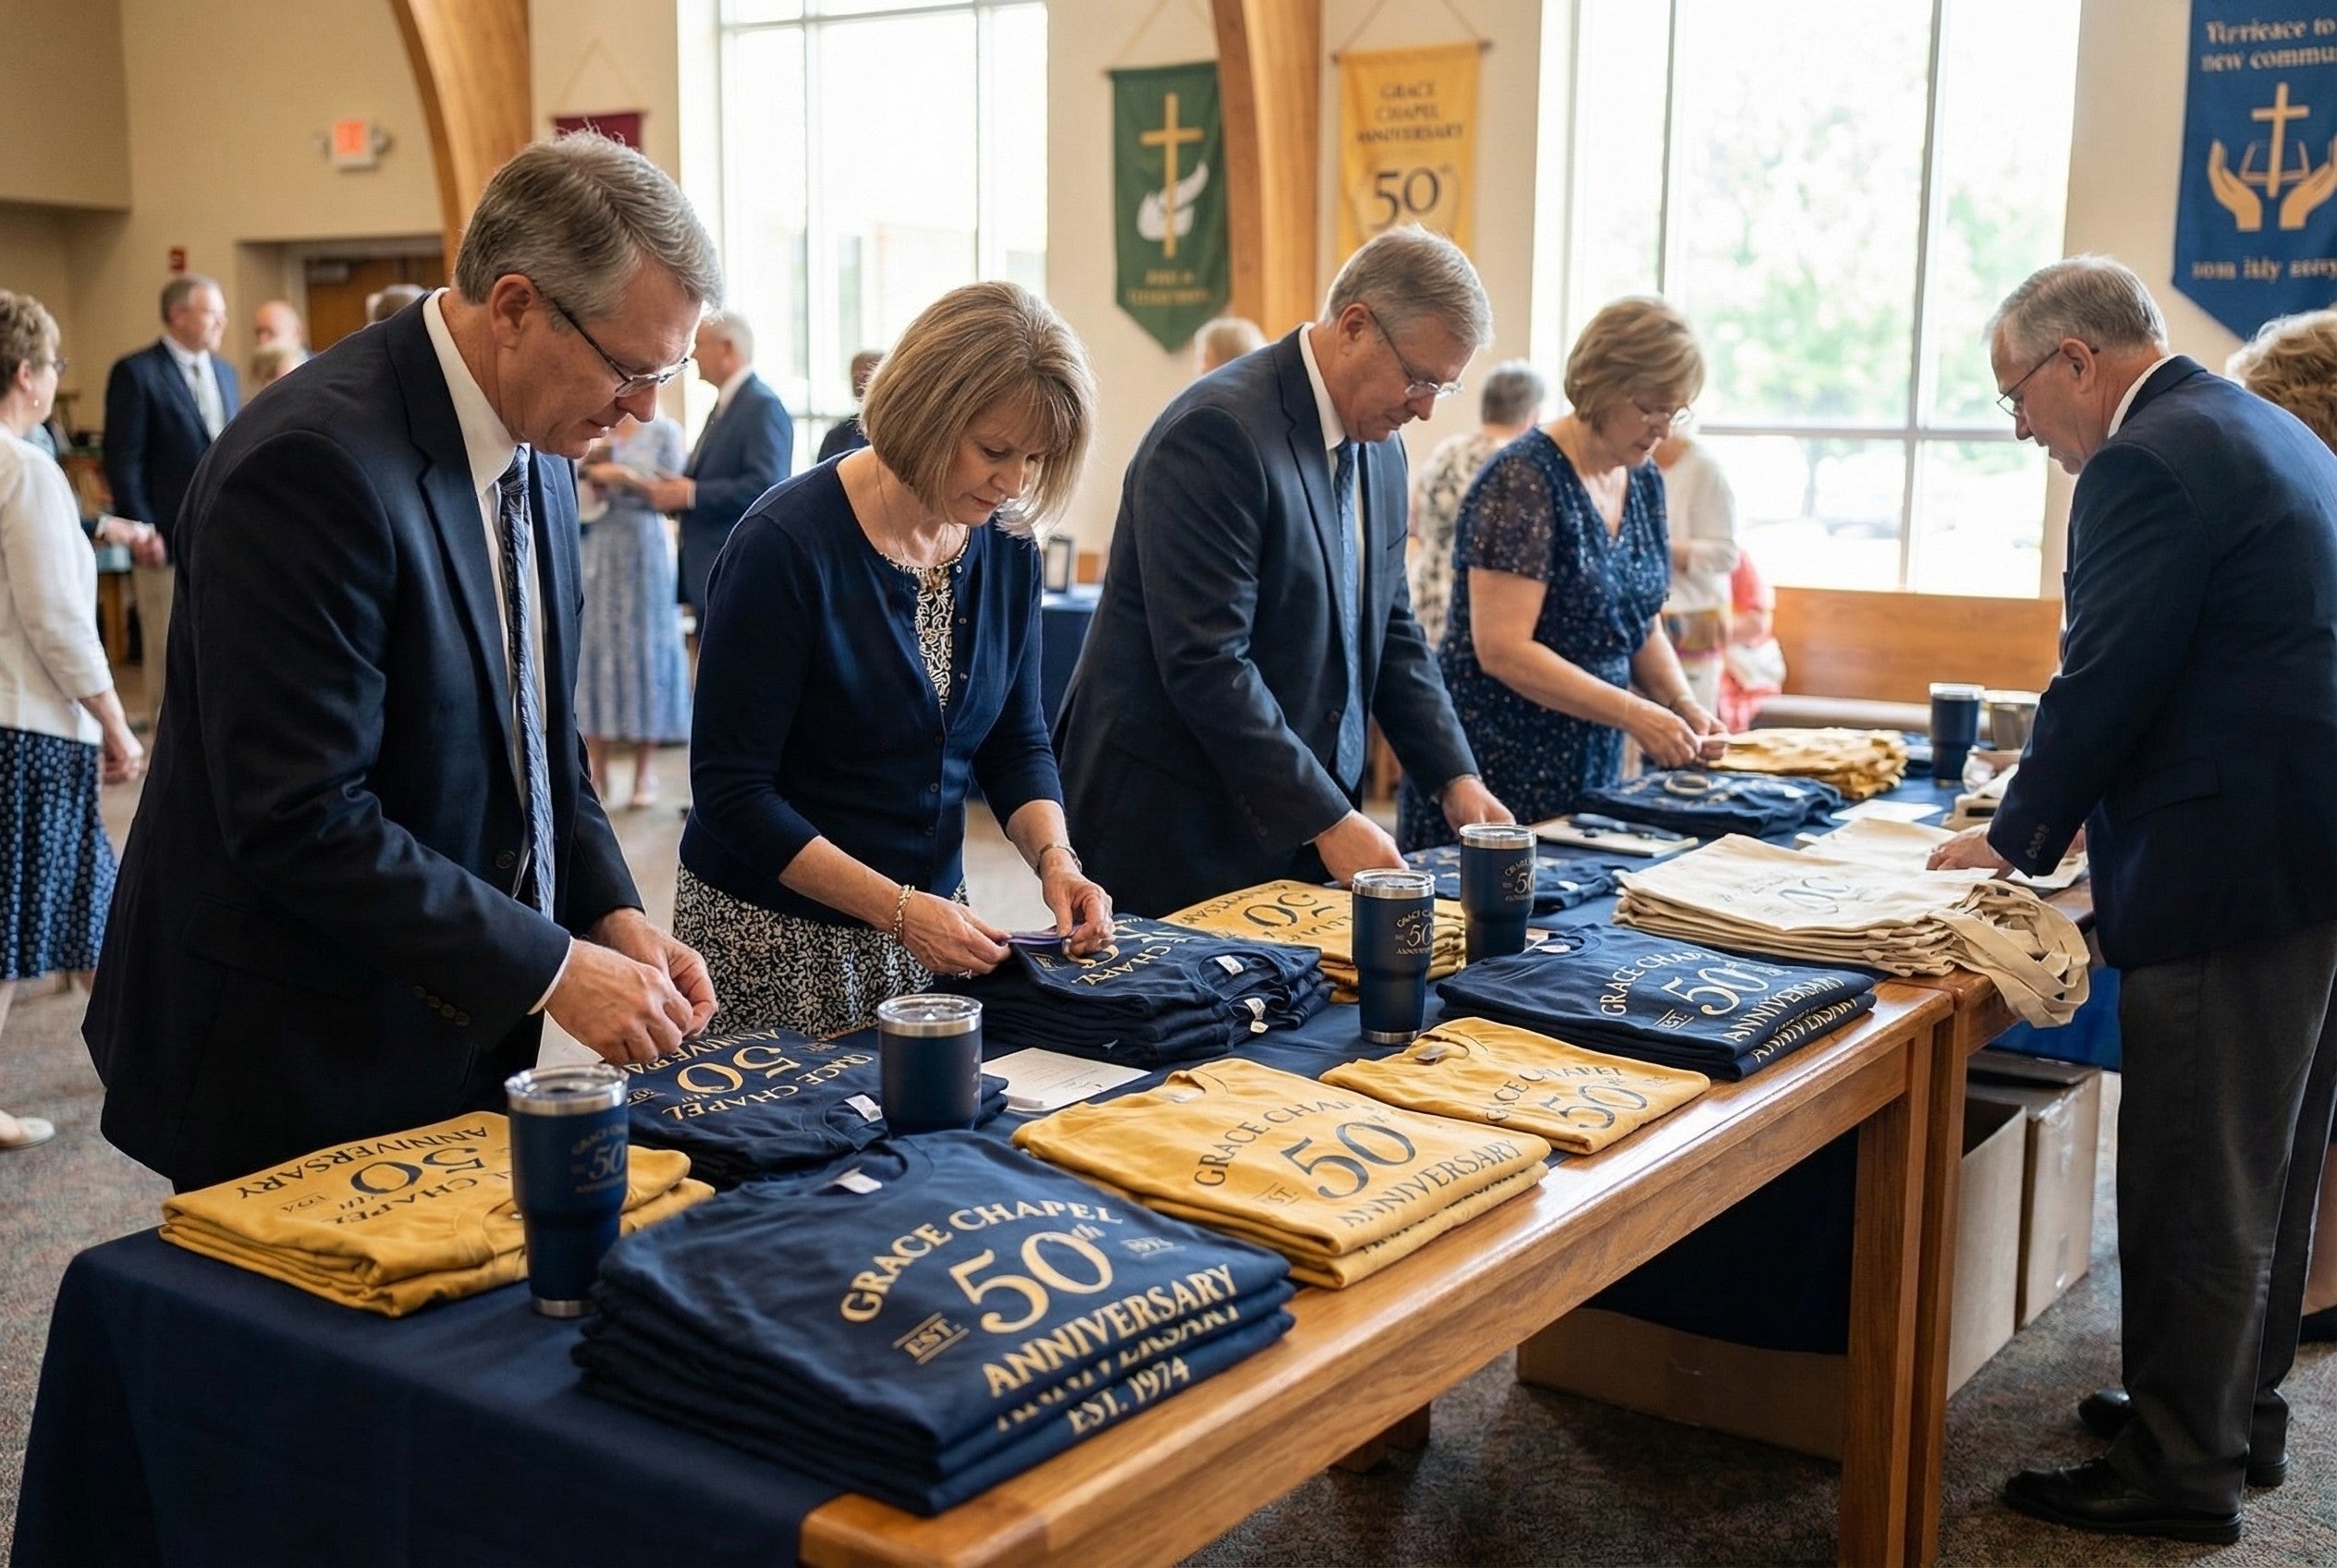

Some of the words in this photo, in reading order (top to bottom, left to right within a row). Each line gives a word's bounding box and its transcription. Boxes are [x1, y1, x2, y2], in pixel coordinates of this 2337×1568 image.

[1407, 923, 1432, 947] 50
[1600, 966, 1646, 1017] GRACE
[662, 1085, 800, 1121] CHAPEL
[237, 1126, 487, 1199] ANNIVERSARY
[589, 1140, 626, 1180] 50
[1194, 1121, 1271, 1187] GRACE
[324, 1178, 478, 1225] CHAPEL
[1340, 1139, 1523, 1228] ANNIVERSARY
[840, 1223, 953, 1323] GRACE
[948, 1200, 1123, 1231] CHAPEL
[903, 1317, 961, 1358] EST.
[982, 1264, 1238, 1399] ANNIVERSARY
[1067, 1389, 1130, 1435] EST.
[1127, 1356, 1191, 1404] 1974
